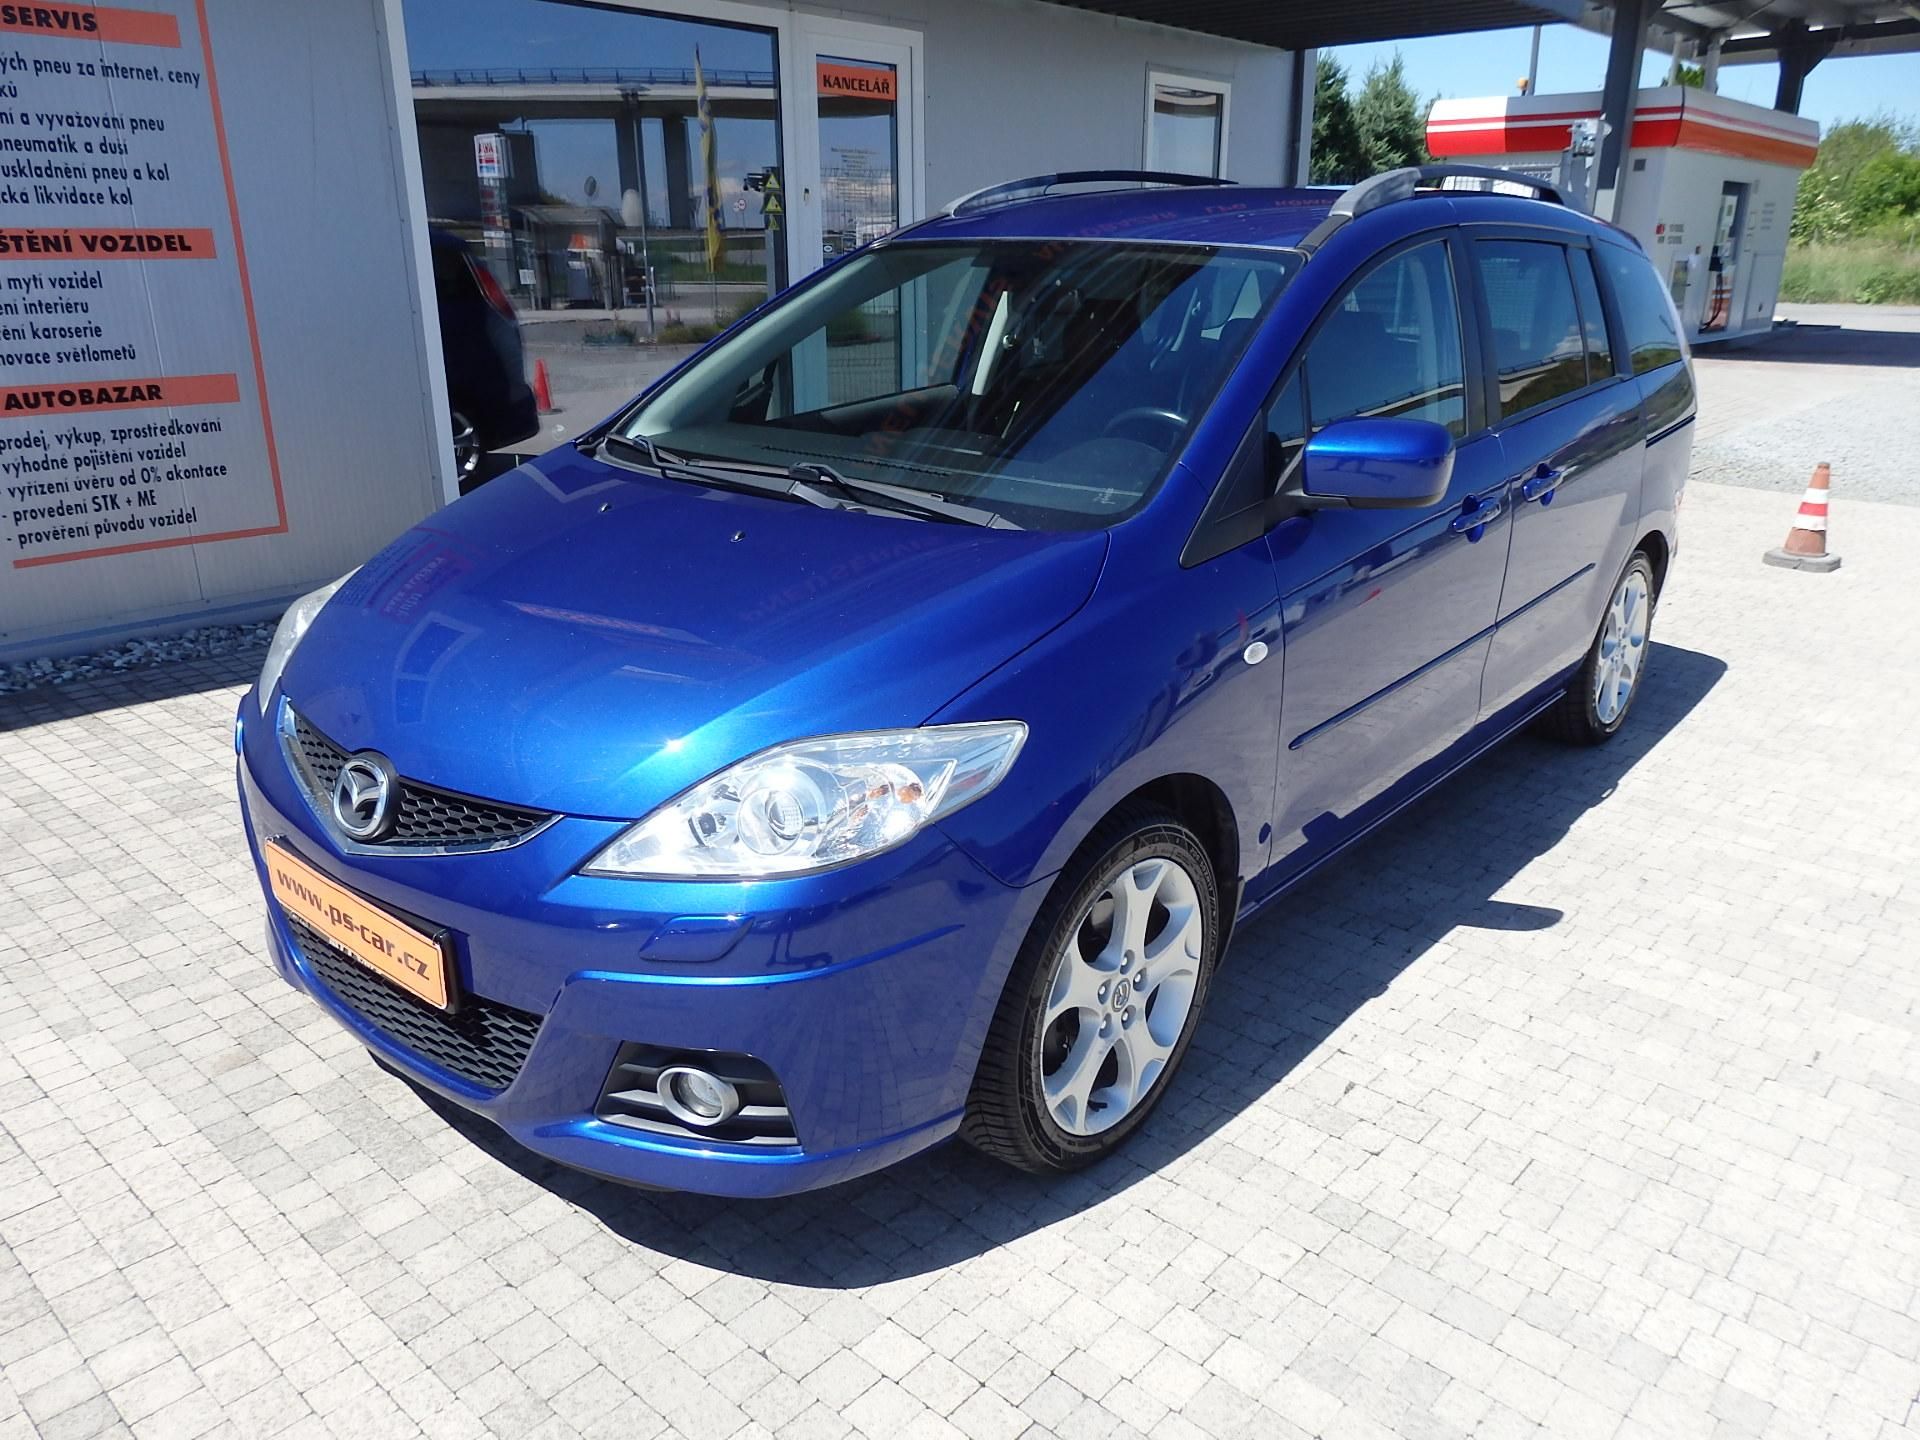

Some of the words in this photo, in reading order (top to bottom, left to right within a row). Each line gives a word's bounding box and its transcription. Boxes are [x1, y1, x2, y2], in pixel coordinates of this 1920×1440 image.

[2, 5, 97, 31] SERVIS
[33, 60, 71, 77] pneu
[76, 63, 95, 76] za
[168, 70, 200, 88] ceny
[823, 74, 890, 94] KANCELÁŘ
[20, 113, 30, 125] a
[130, 118, 164, 134] pneu
[84, 141, 93, 154] a
[1, 158, 87, 179] uskladnění
[92, 167, 127, 184] pneu
[133, 168, 142, 180] a
[146, 163, 170, 181] kol
[34, 185, 104, 205] likvidace
[109, 186, 133, 205] kol
[80, 235, 192, 252] VOZIDEL
[48, 270, 103, 289] vozidel
[22, 296, 89, 314] interiéru
[29, 320, 102, 340] karoserie
[56, 343, 136, 364] světlometů
[4, 384, 163, 410] AUTOBAZAR
[110, 417, 222, 444] zprostředkování
[2, 453, 68, 479] výhodné
[74, 448, 133, 472] pojištění
[137, 441, 187, 461] vozidel
[74, 475, 114, 491] úvěru
[119, 468, 136, 486] od
[140, 465, 162, 484] 0%
[166, 464, 227, 481] akontace
[13, 499, 88, 526] provedení
[92, 494, 121, 513] STK
[137, 489, 157, 507] ME
[18, 522, 90, 549] prověření
[94, 514, 145, 539] původu
[149, 507, 197, 527] vozidel
[277, 868, 431, 981] www.ps-car.cz
